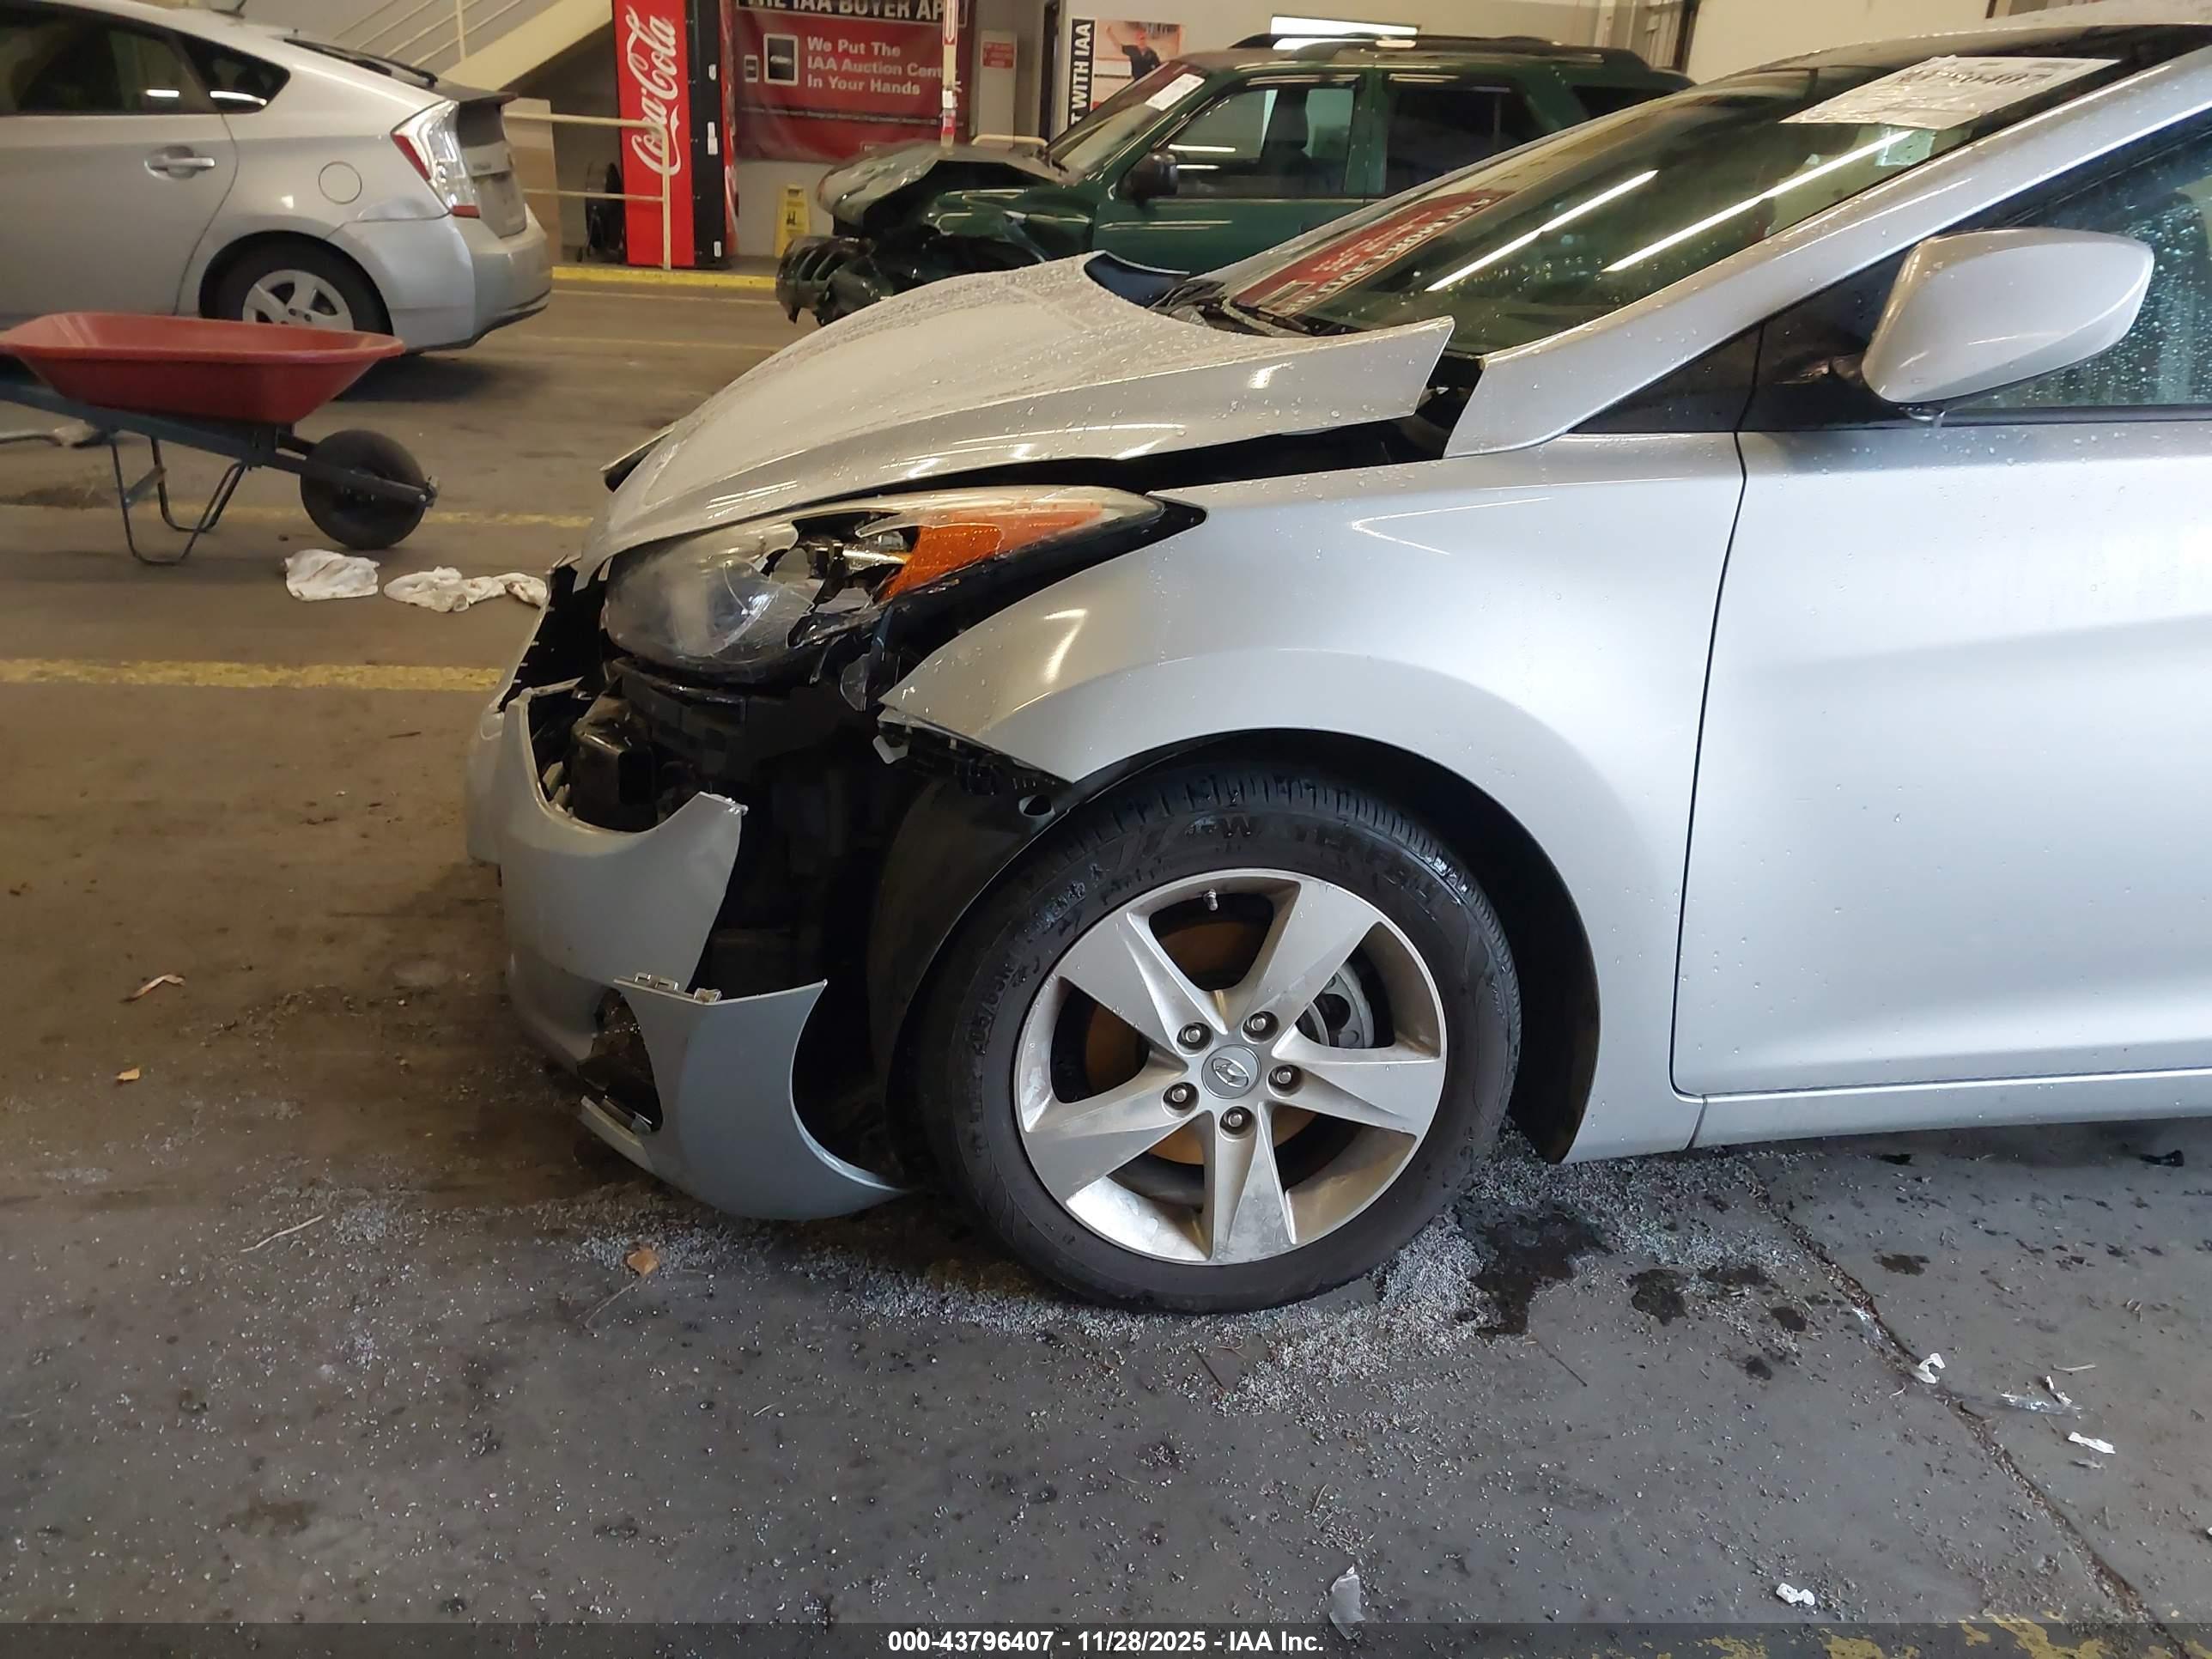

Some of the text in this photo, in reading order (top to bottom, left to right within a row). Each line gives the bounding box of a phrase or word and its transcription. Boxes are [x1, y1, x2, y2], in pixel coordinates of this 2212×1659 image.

[838, 0, 910, 19] BUYER
[916, 0, 945, 21] AP
[807, 35, 901, 58] We Put The
[1073, 23, 1092, 57] IAA
[807, 55, 957, 78] IAA Auction Cent
[807, 74, 921, 95] In Your Hands
[1071, 61, 1089, 109] WITH
